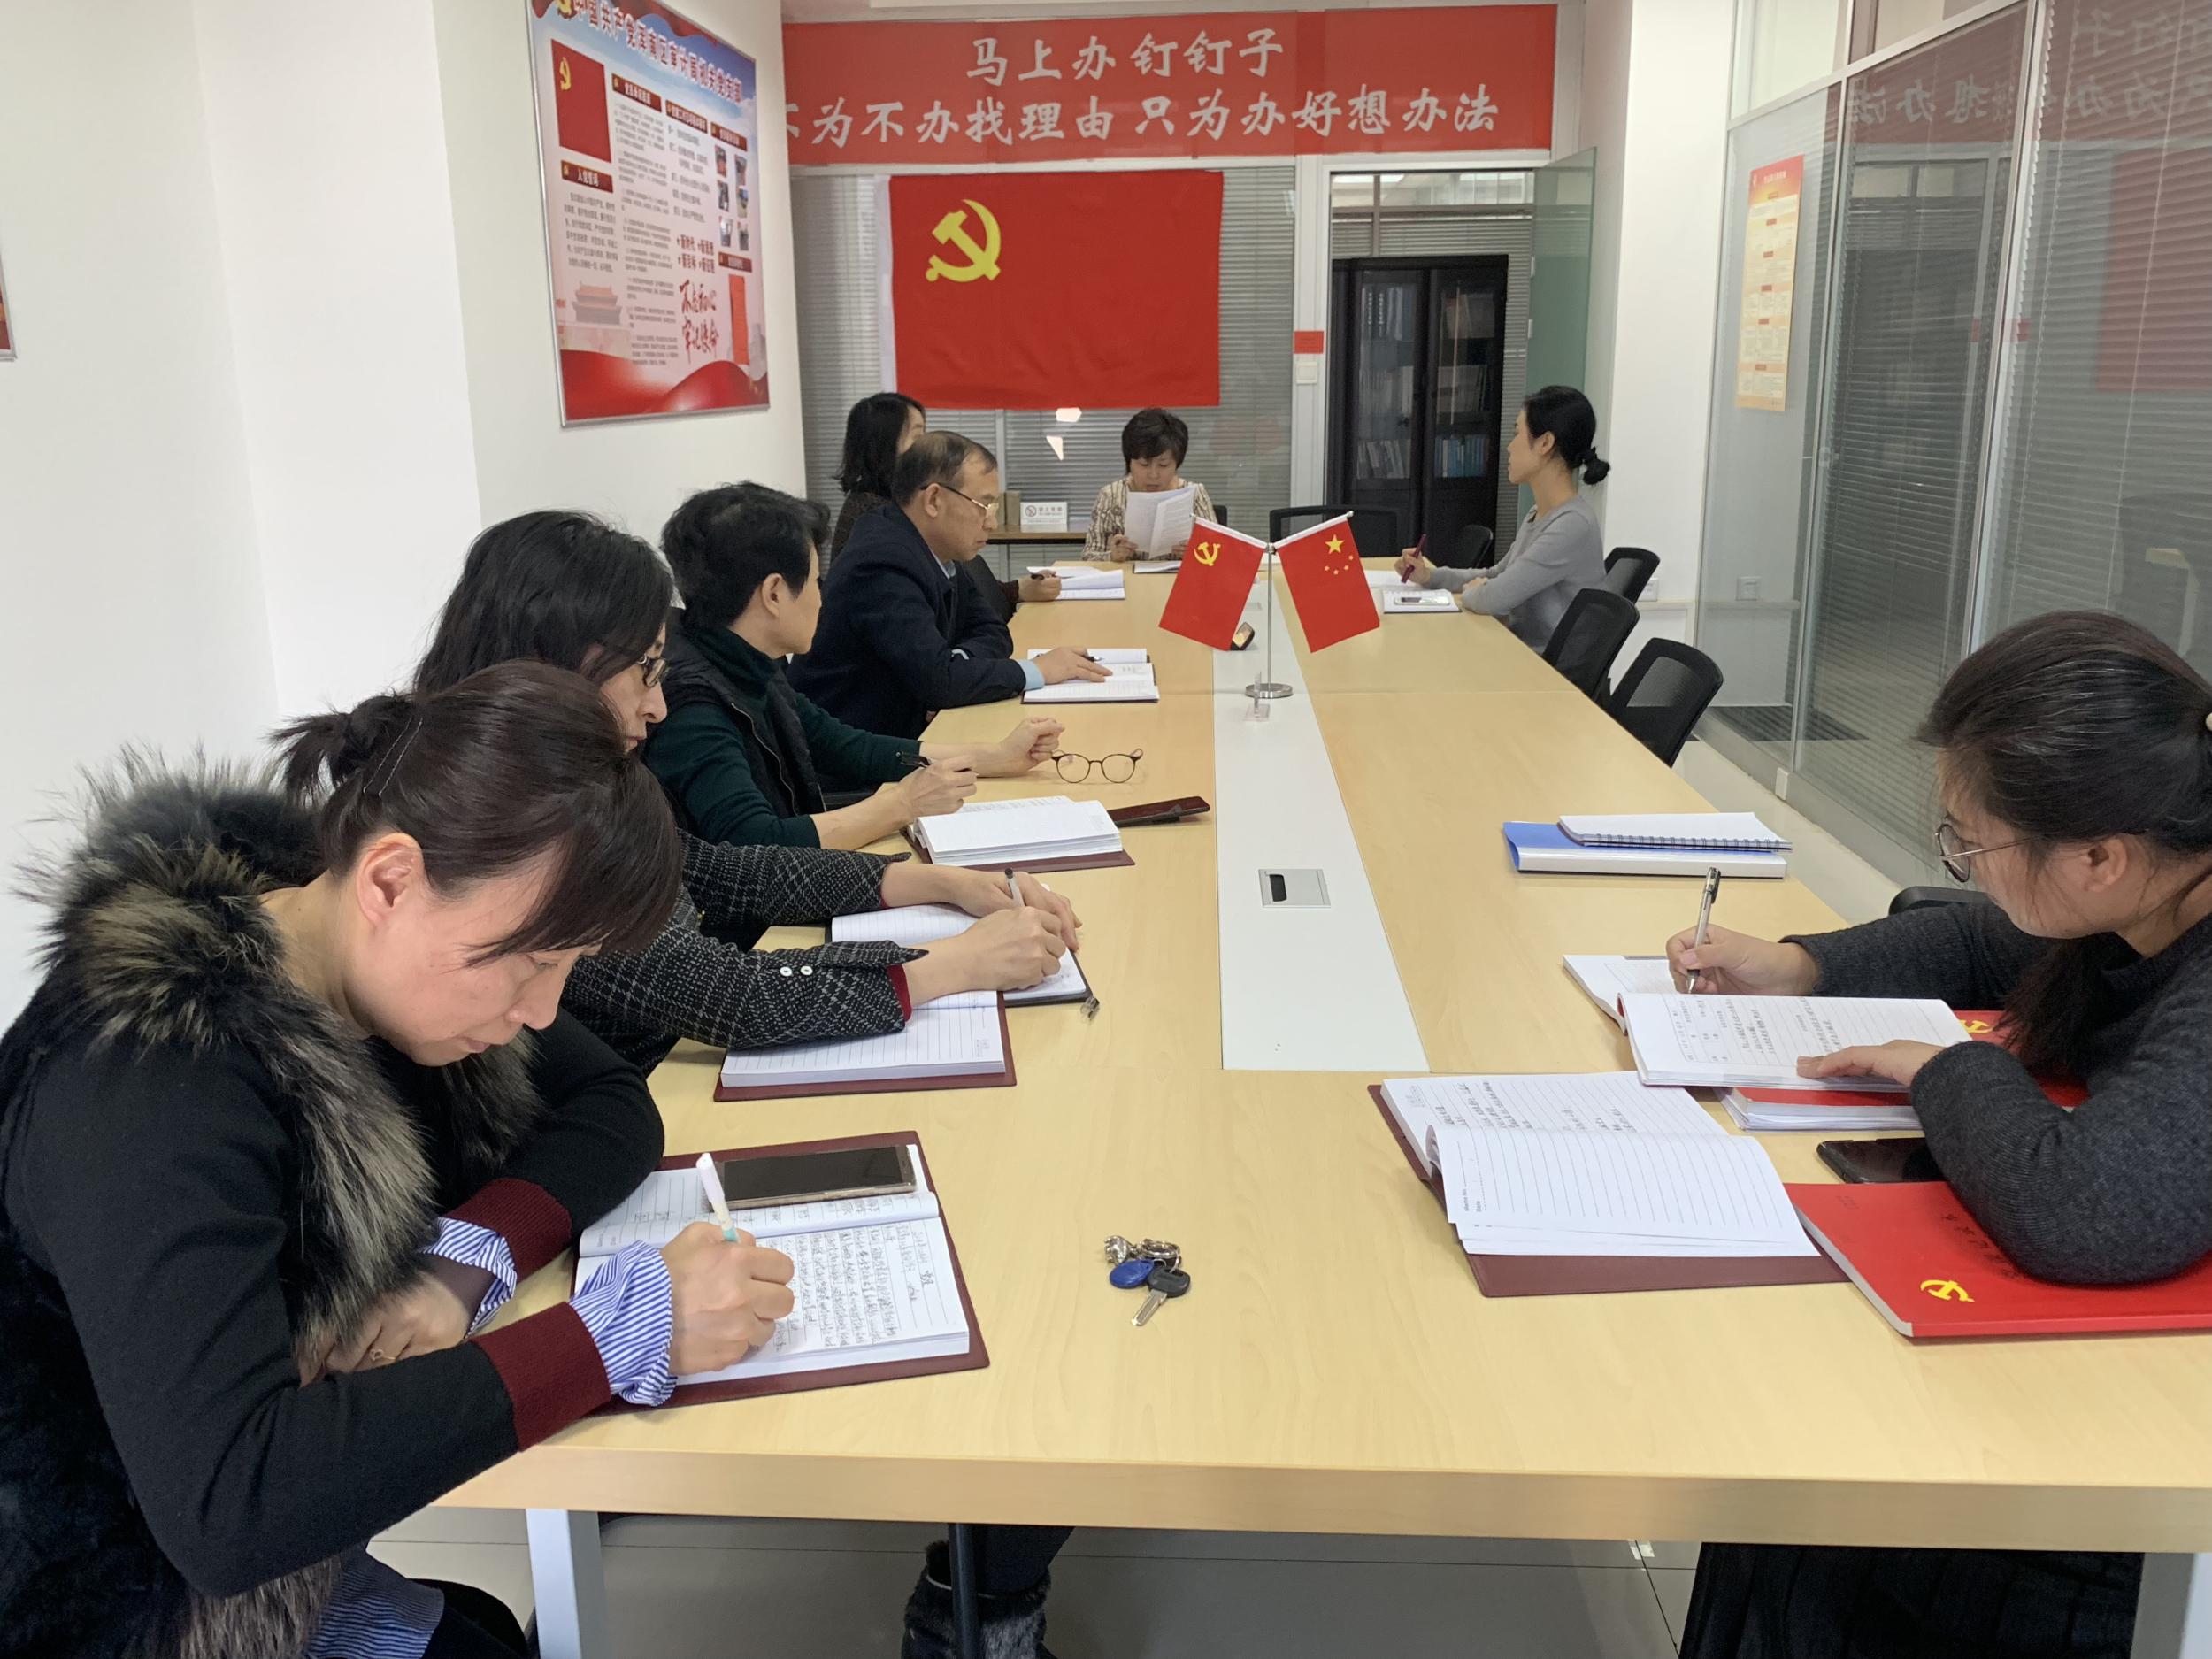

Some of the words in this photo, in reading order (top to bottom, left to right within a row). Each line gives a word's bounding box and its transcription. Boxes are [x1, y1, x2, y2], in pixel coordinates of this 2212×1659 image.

[966, 27, 1284, 87] 马上办钉钉子
[1135, 83, 1499, 142] 只为办好想办法
